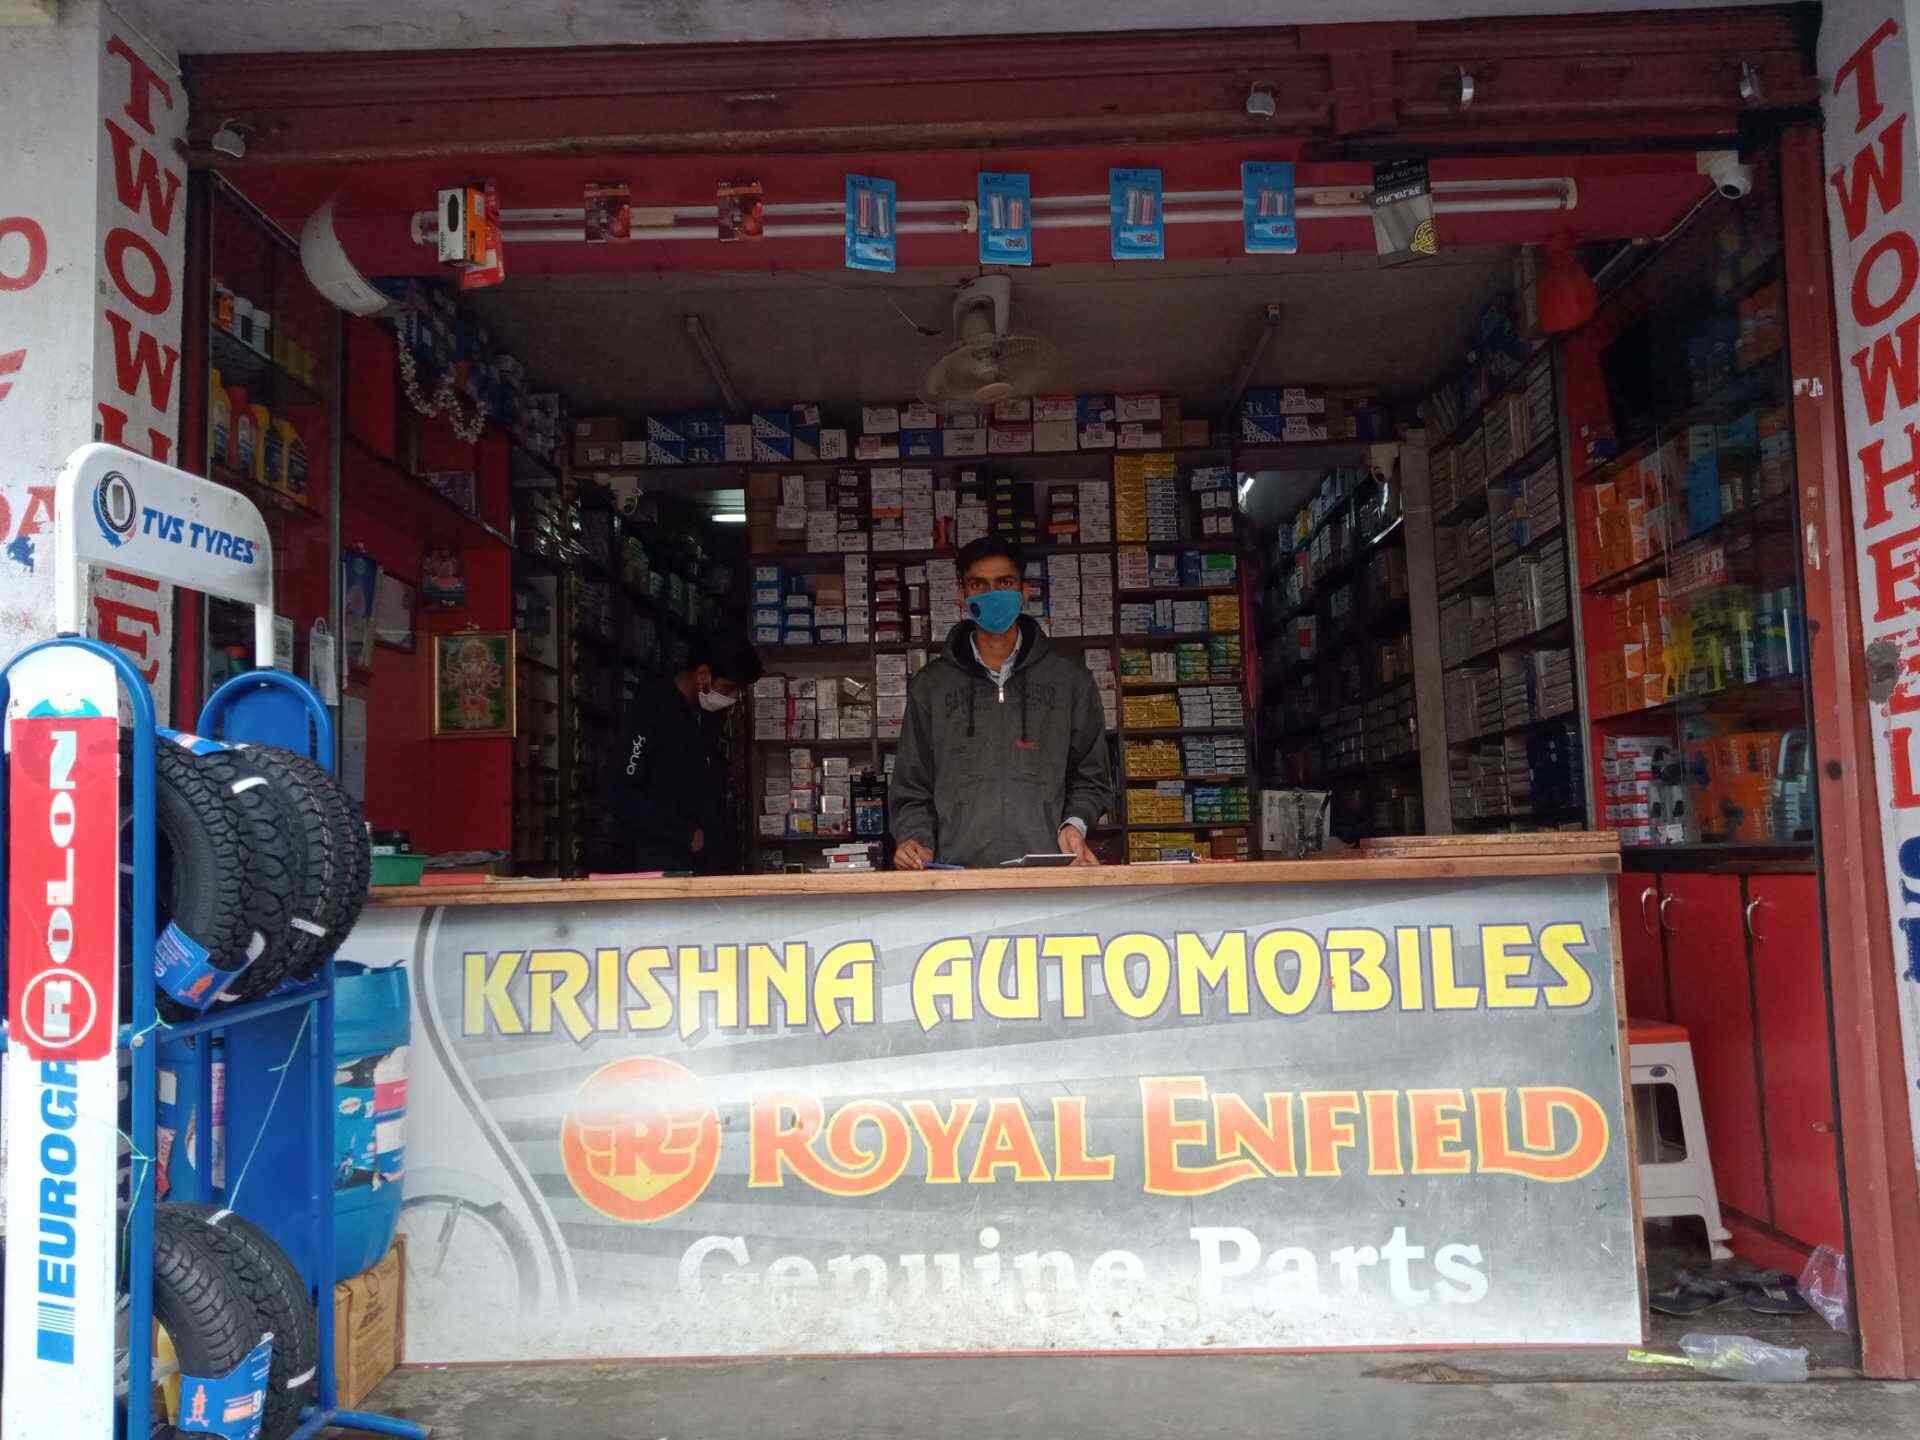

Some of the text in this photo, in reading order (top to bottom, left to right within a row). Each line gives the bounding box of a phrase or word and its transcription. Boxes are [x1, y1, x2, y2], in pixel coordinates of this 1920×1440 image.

[142, 506, 254, 565] TVS TYRES
[40, 729, 80, 1041] ROLON
[462, 922, 1594, 1044] KRISHNA AUTOMOBILES
[38, 1058, 78, 1299] EUROGR
[745, 1075, 1611, 1196] ROYAL ENFIELD
[676, 1225, 1490, 1305] Genuine Parts
